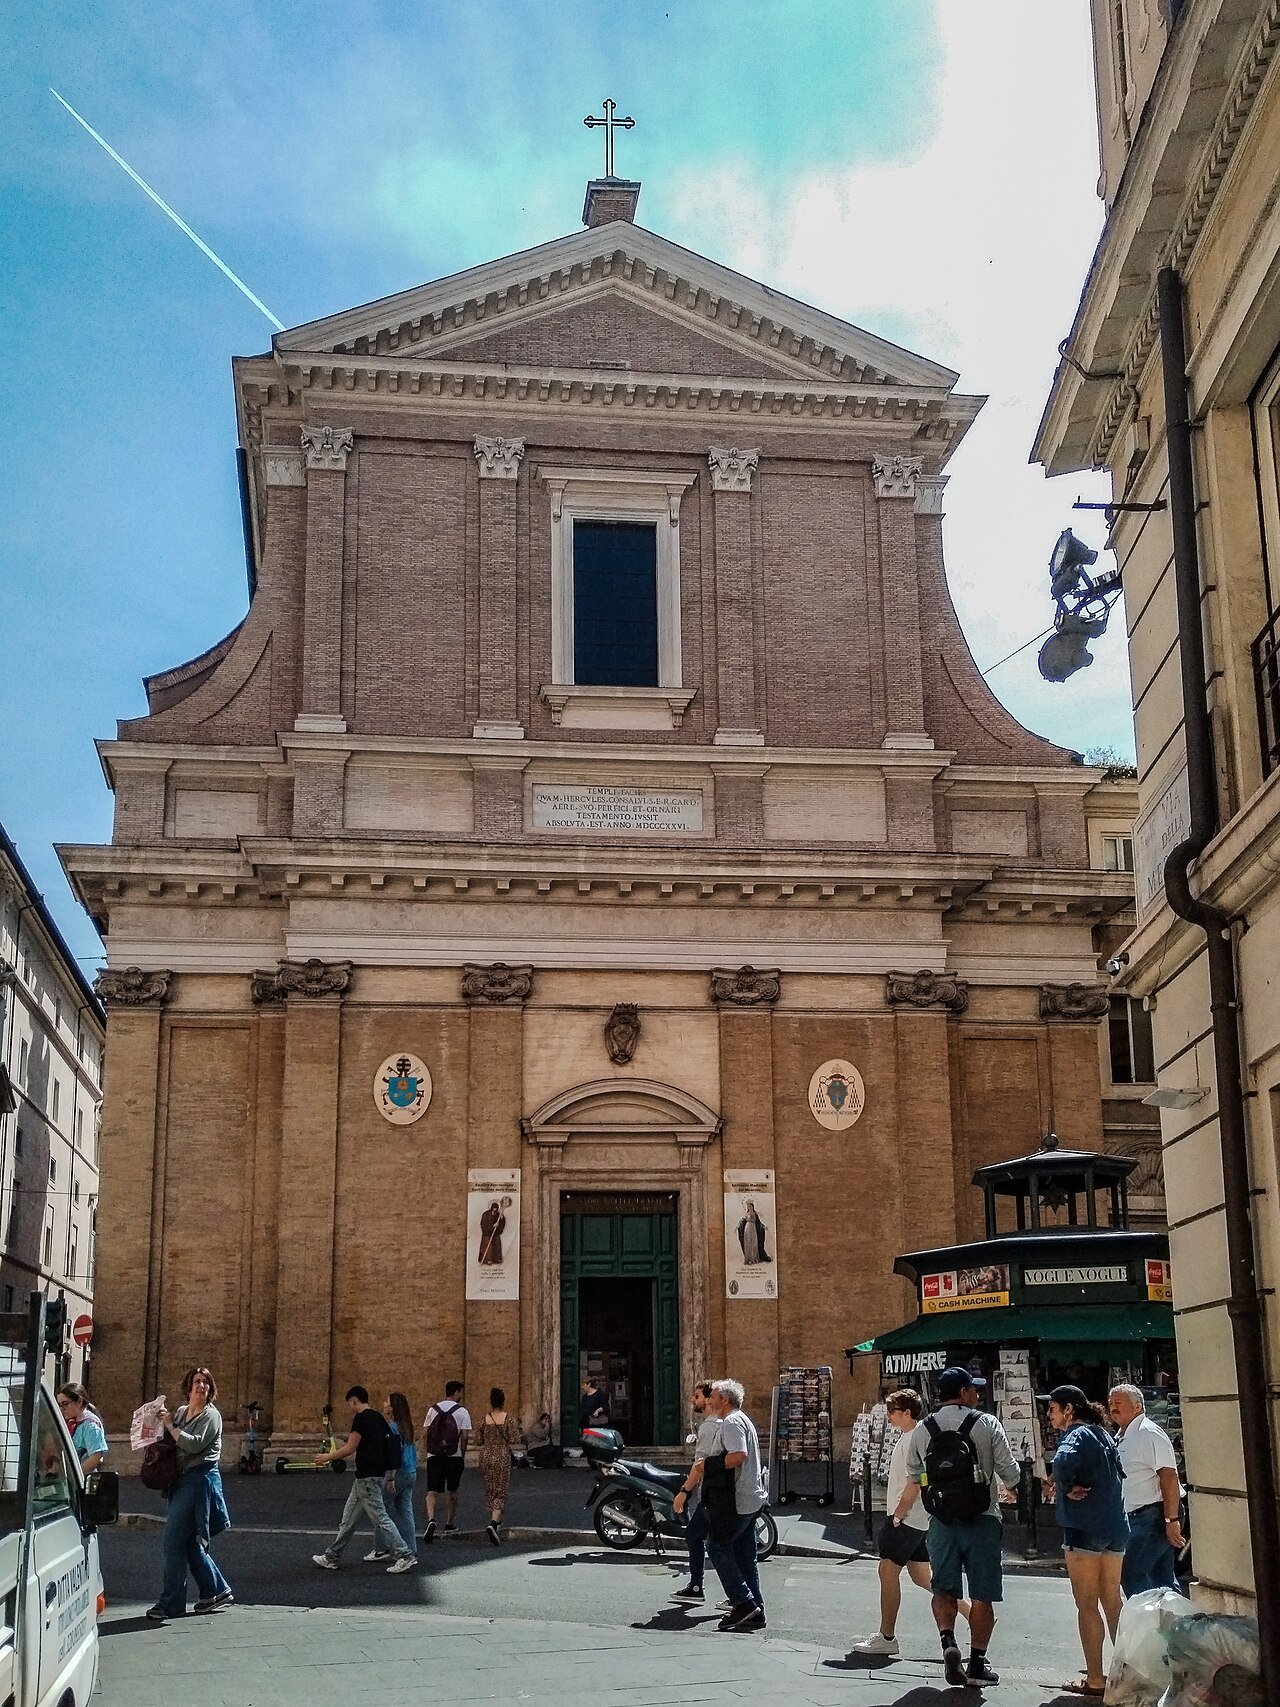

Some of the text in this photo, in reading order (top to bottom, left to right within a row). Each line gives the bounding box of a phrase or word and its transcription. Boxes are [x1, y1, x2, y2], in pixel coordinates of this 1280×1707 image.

[536, 795, 559, 804] QVAM
[1161, 790, 1181, 820] VIA
[576, 812, 631, 820] TESTAMENTO
[606, 821, 632, 829] ANNO
[1161, 813, 1185, 849] DELLA
[1025, 1268, 1127, 1282] VOGUE VOGUE
[938, 1296, 1002, 1309] CASH MACHINE
[885, 1350, 947, 1374] ATM HERE
